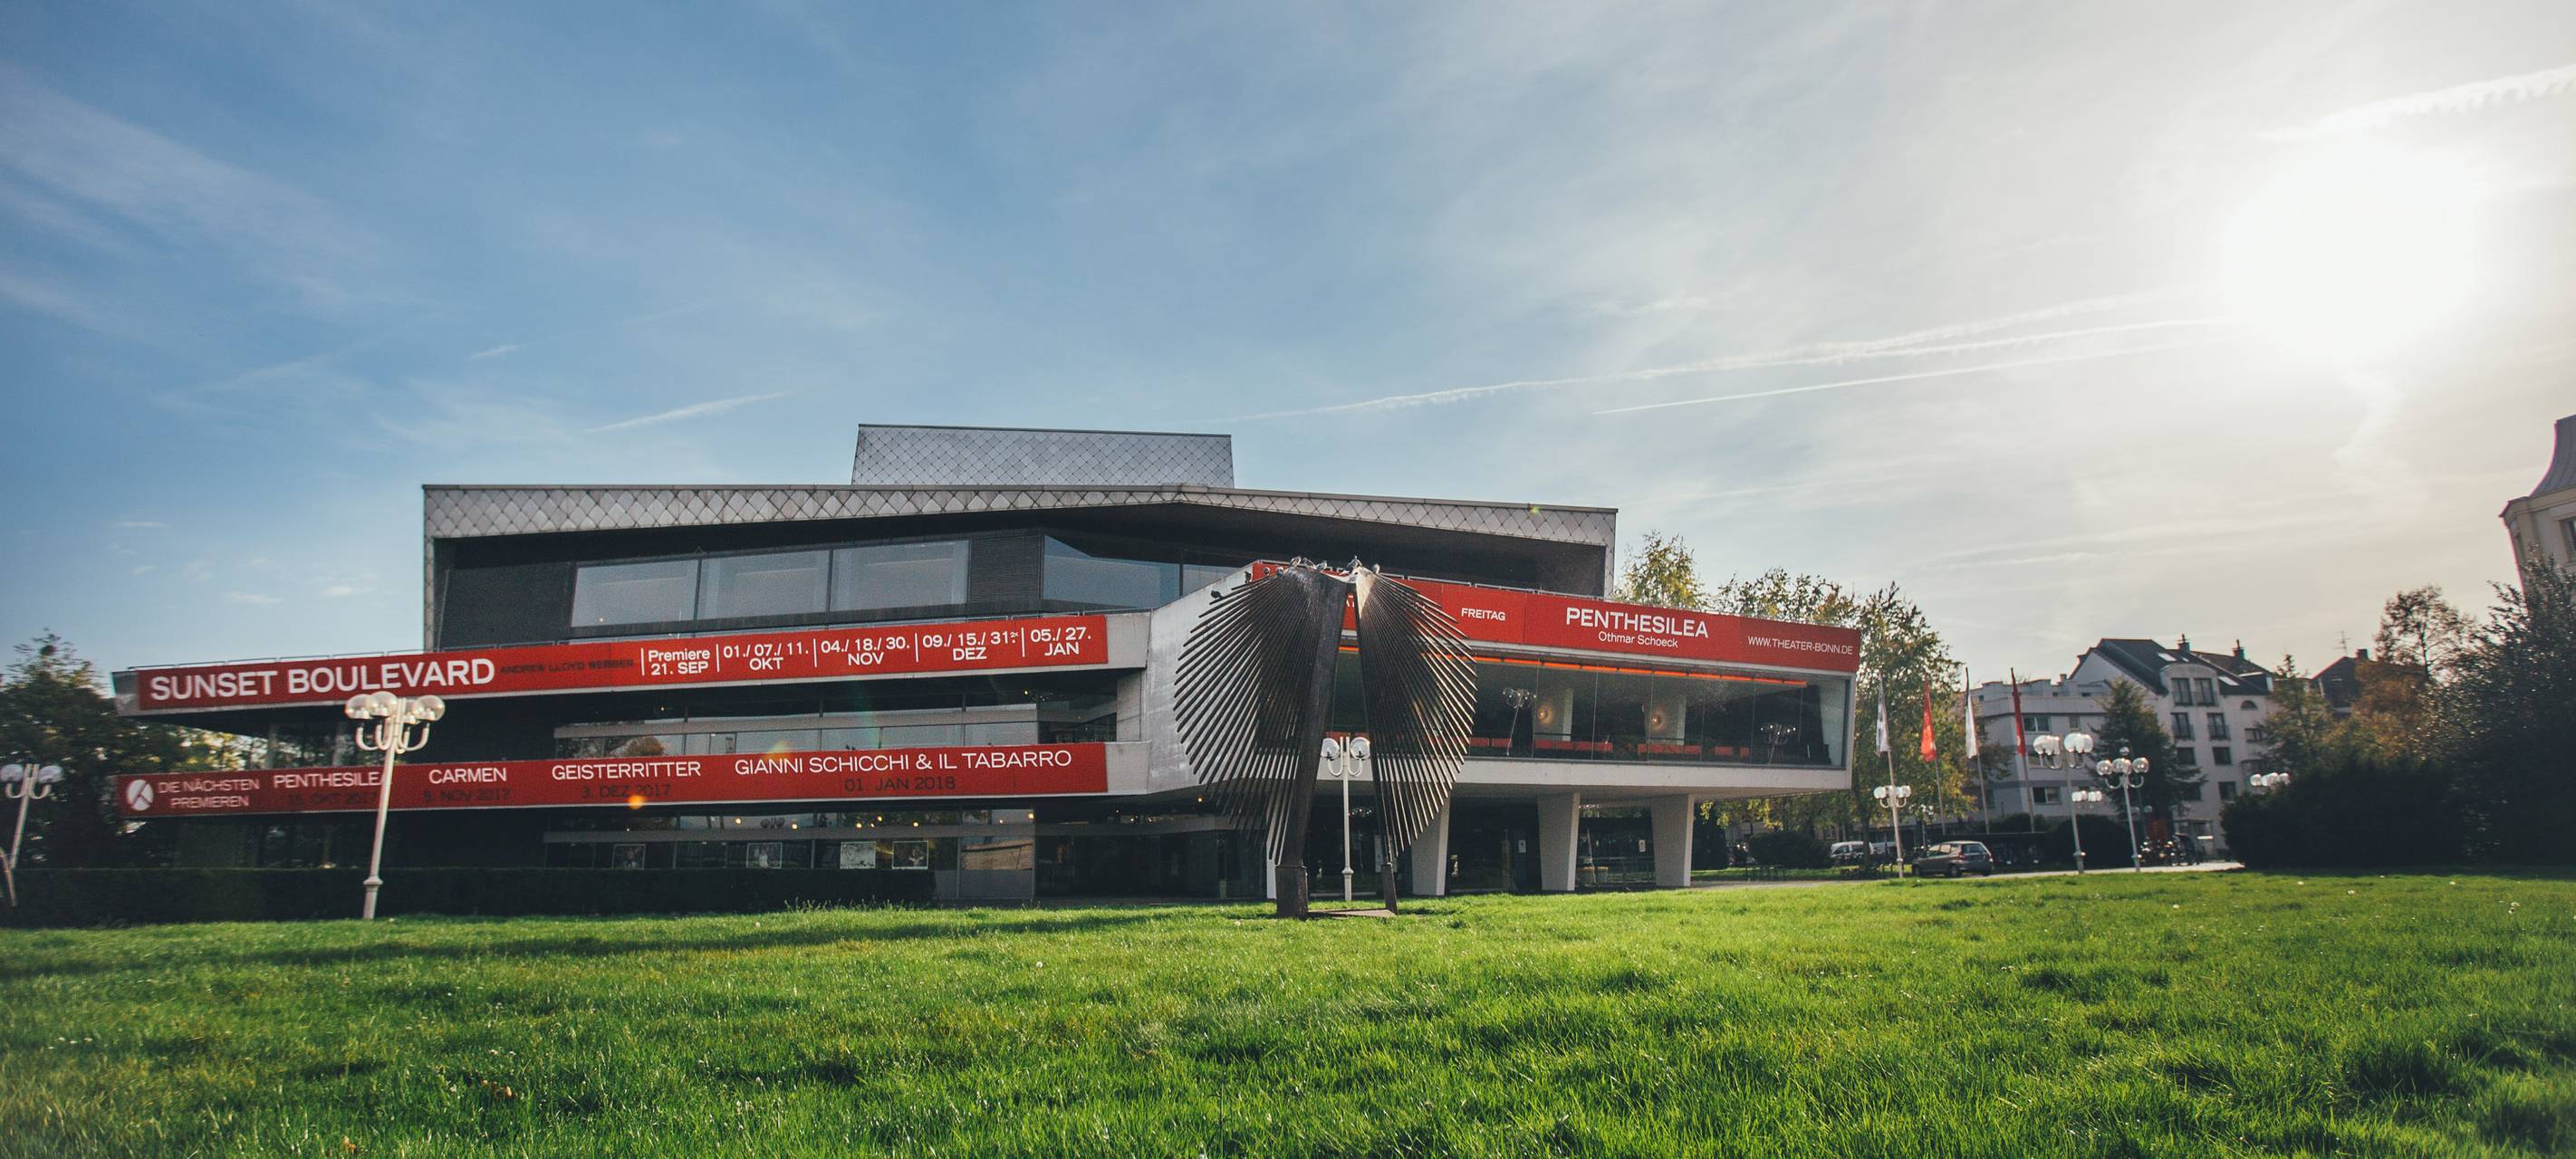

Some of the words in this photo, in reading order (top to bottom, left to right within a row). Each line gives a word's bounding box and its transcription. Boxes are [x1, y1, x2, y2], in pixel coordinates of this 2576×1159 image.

[1461, 608, 1506, 621] FREITAG
[1565, 607, 1709, 638] PENTHESILEA
[1065, 627, 1091, 641] 27.
[1598, 631, 1636, 645] Othmar
[1638, 635, 1678, 648] Schoeck
[787, 641, 809, 655] 11.
[886, 637, 910, 649] 30.
[1044, 642, 1080, 656] JAN
[1747, 636, 1854, 655] WWW.THEATER-BONN.DE
[648, 647, 710, 663] Premiere
[847, 652, 884, 666] NOV
[953, 647, 987, 661] DEZ
[548, 661, 586, 672] LLOYD
[650, 663, 673, 675] 21.
[678, 661, 709, 675] SEP
[749, 657, 783, 671] OKT
[149, 670, 278, 701] SUNSET
[288, 658, 495, 694] BOULEVARD
[735, 757, 803, 775] GIANNI
[809, 754, 909, 772] SCHICCHI
[915, 753, 933, 770] &
[939, 753, 957, 769] IL
[962, 750, 1072, 769] TABARRO
[428, 767, 507, 785] CARMEN
[552, 761, 702, 781] GEISTERRITTER
[158, 781, 181, 794] DIE
[183, 778, 261, 792] NÄCHSTEN
[844, 778, 867, 791] 01.
[875, 777, 909, 790] JAN
[914, 775, 956, 790] 2018
[599, 784, 630, 798] DEZ
[170, 795, 250, 809] PREMIEREN
